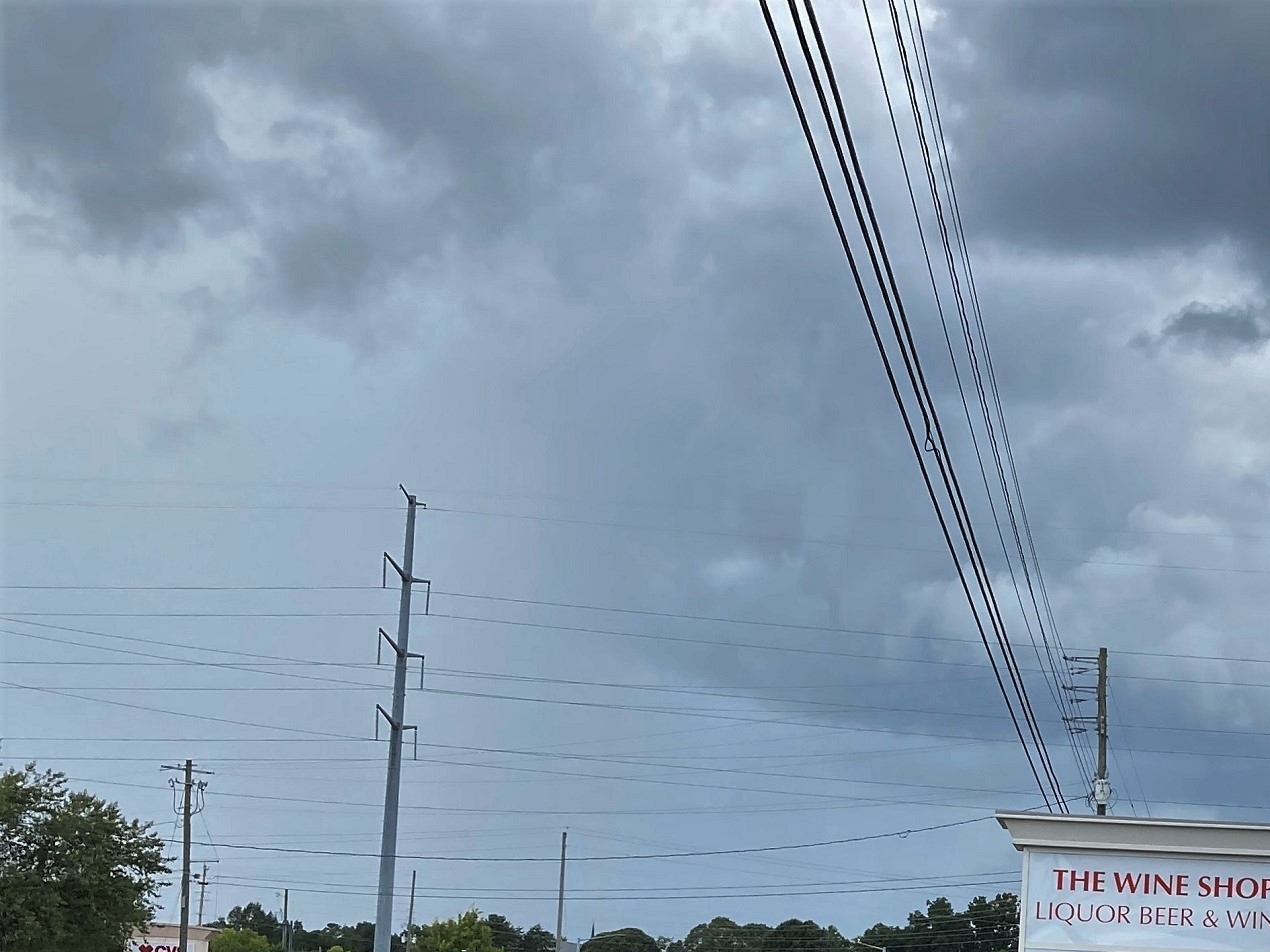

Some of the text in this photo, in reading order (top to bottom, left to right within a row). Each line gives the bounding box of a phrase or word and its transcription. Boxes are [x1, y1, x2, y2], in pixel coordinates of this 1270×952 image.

[1053, 869, 1106, 893] THE
[1113, 872, 1189, 896] WINE
[1036, 901, 1131, 926] LIQUOR
[1140, 906, 1194, 927] BEER
[1202, 909, 1219, 928] &
